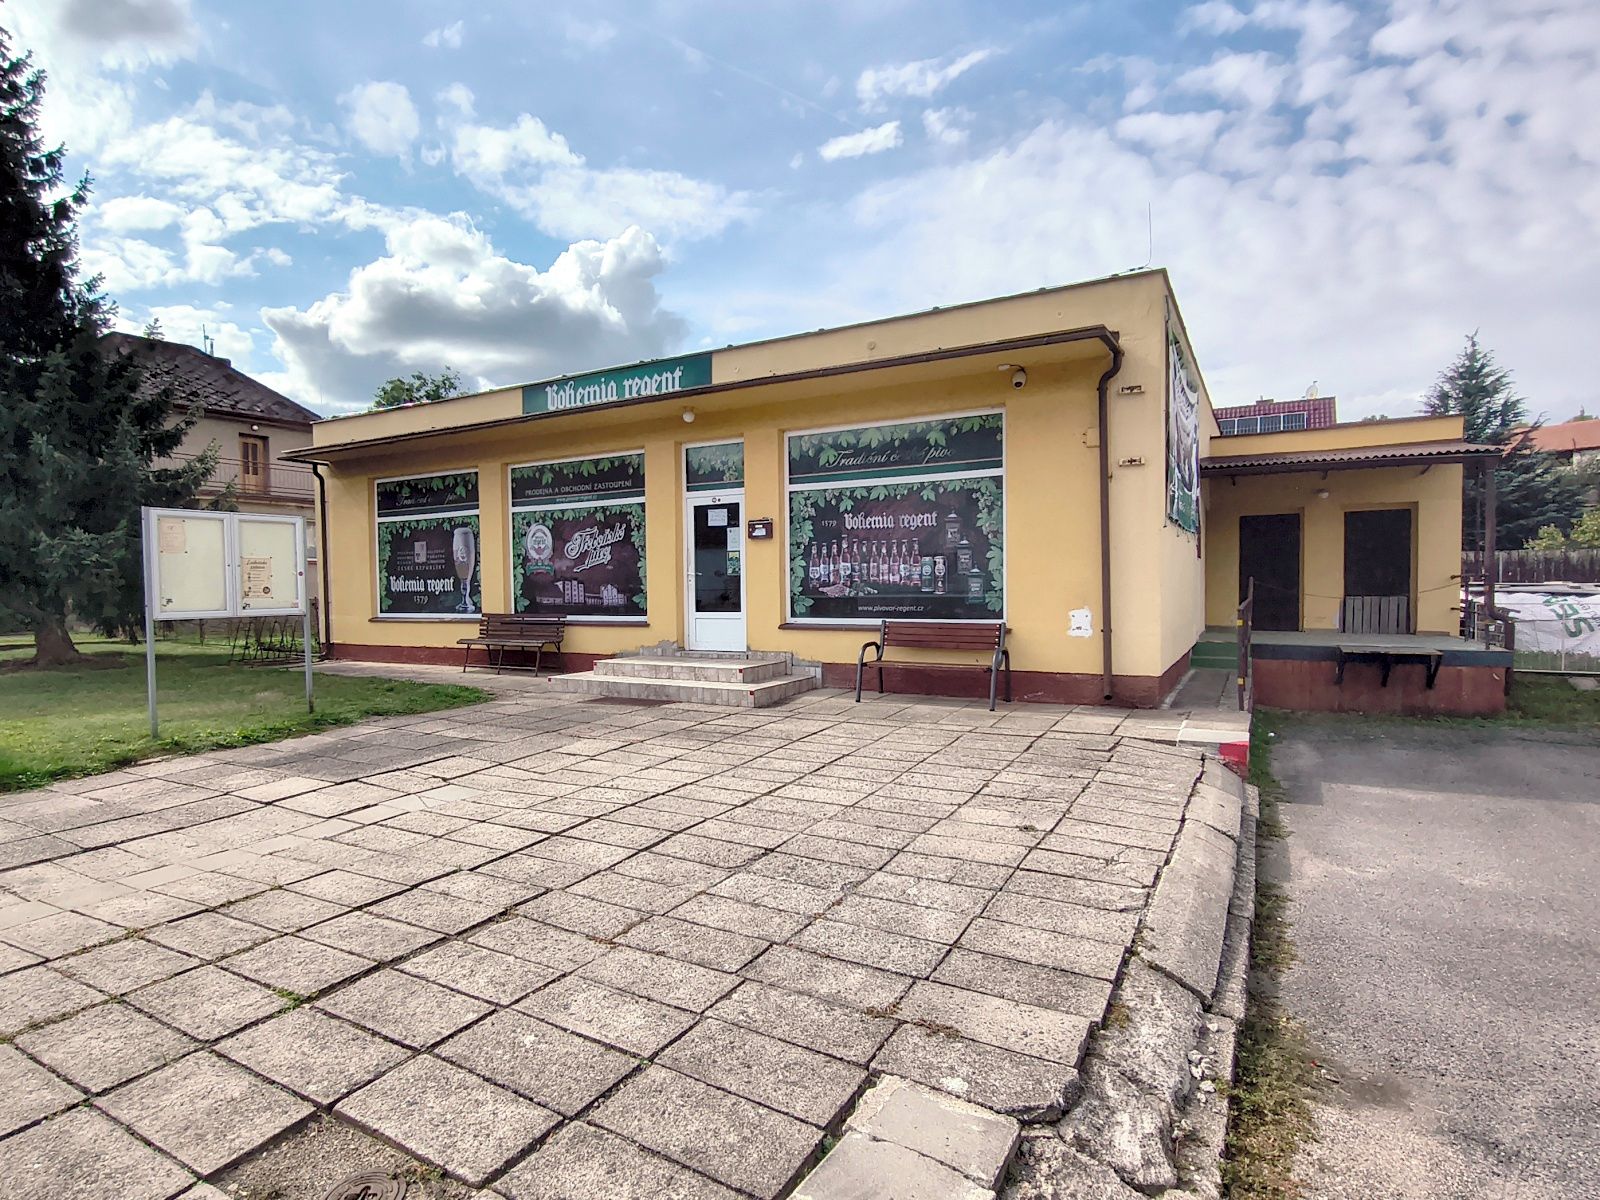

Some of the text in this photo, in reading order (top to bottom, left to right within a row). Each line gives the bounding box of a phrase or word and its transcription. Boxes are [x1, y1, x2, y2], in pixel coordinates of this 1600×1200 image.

[545, 365, 684, 411] Bohemia regent
[525, 487, 553, 496] PRODEJNA
[560, 482, 592, 493] OBCHODNÍ
[593, 478, 632, 490] ZASTOUPENÍ
[843, 511, 895, 530] Bohemia
[899, 510, 938, 531] regent
[389, 575, 455, 595] Bohemia regent
